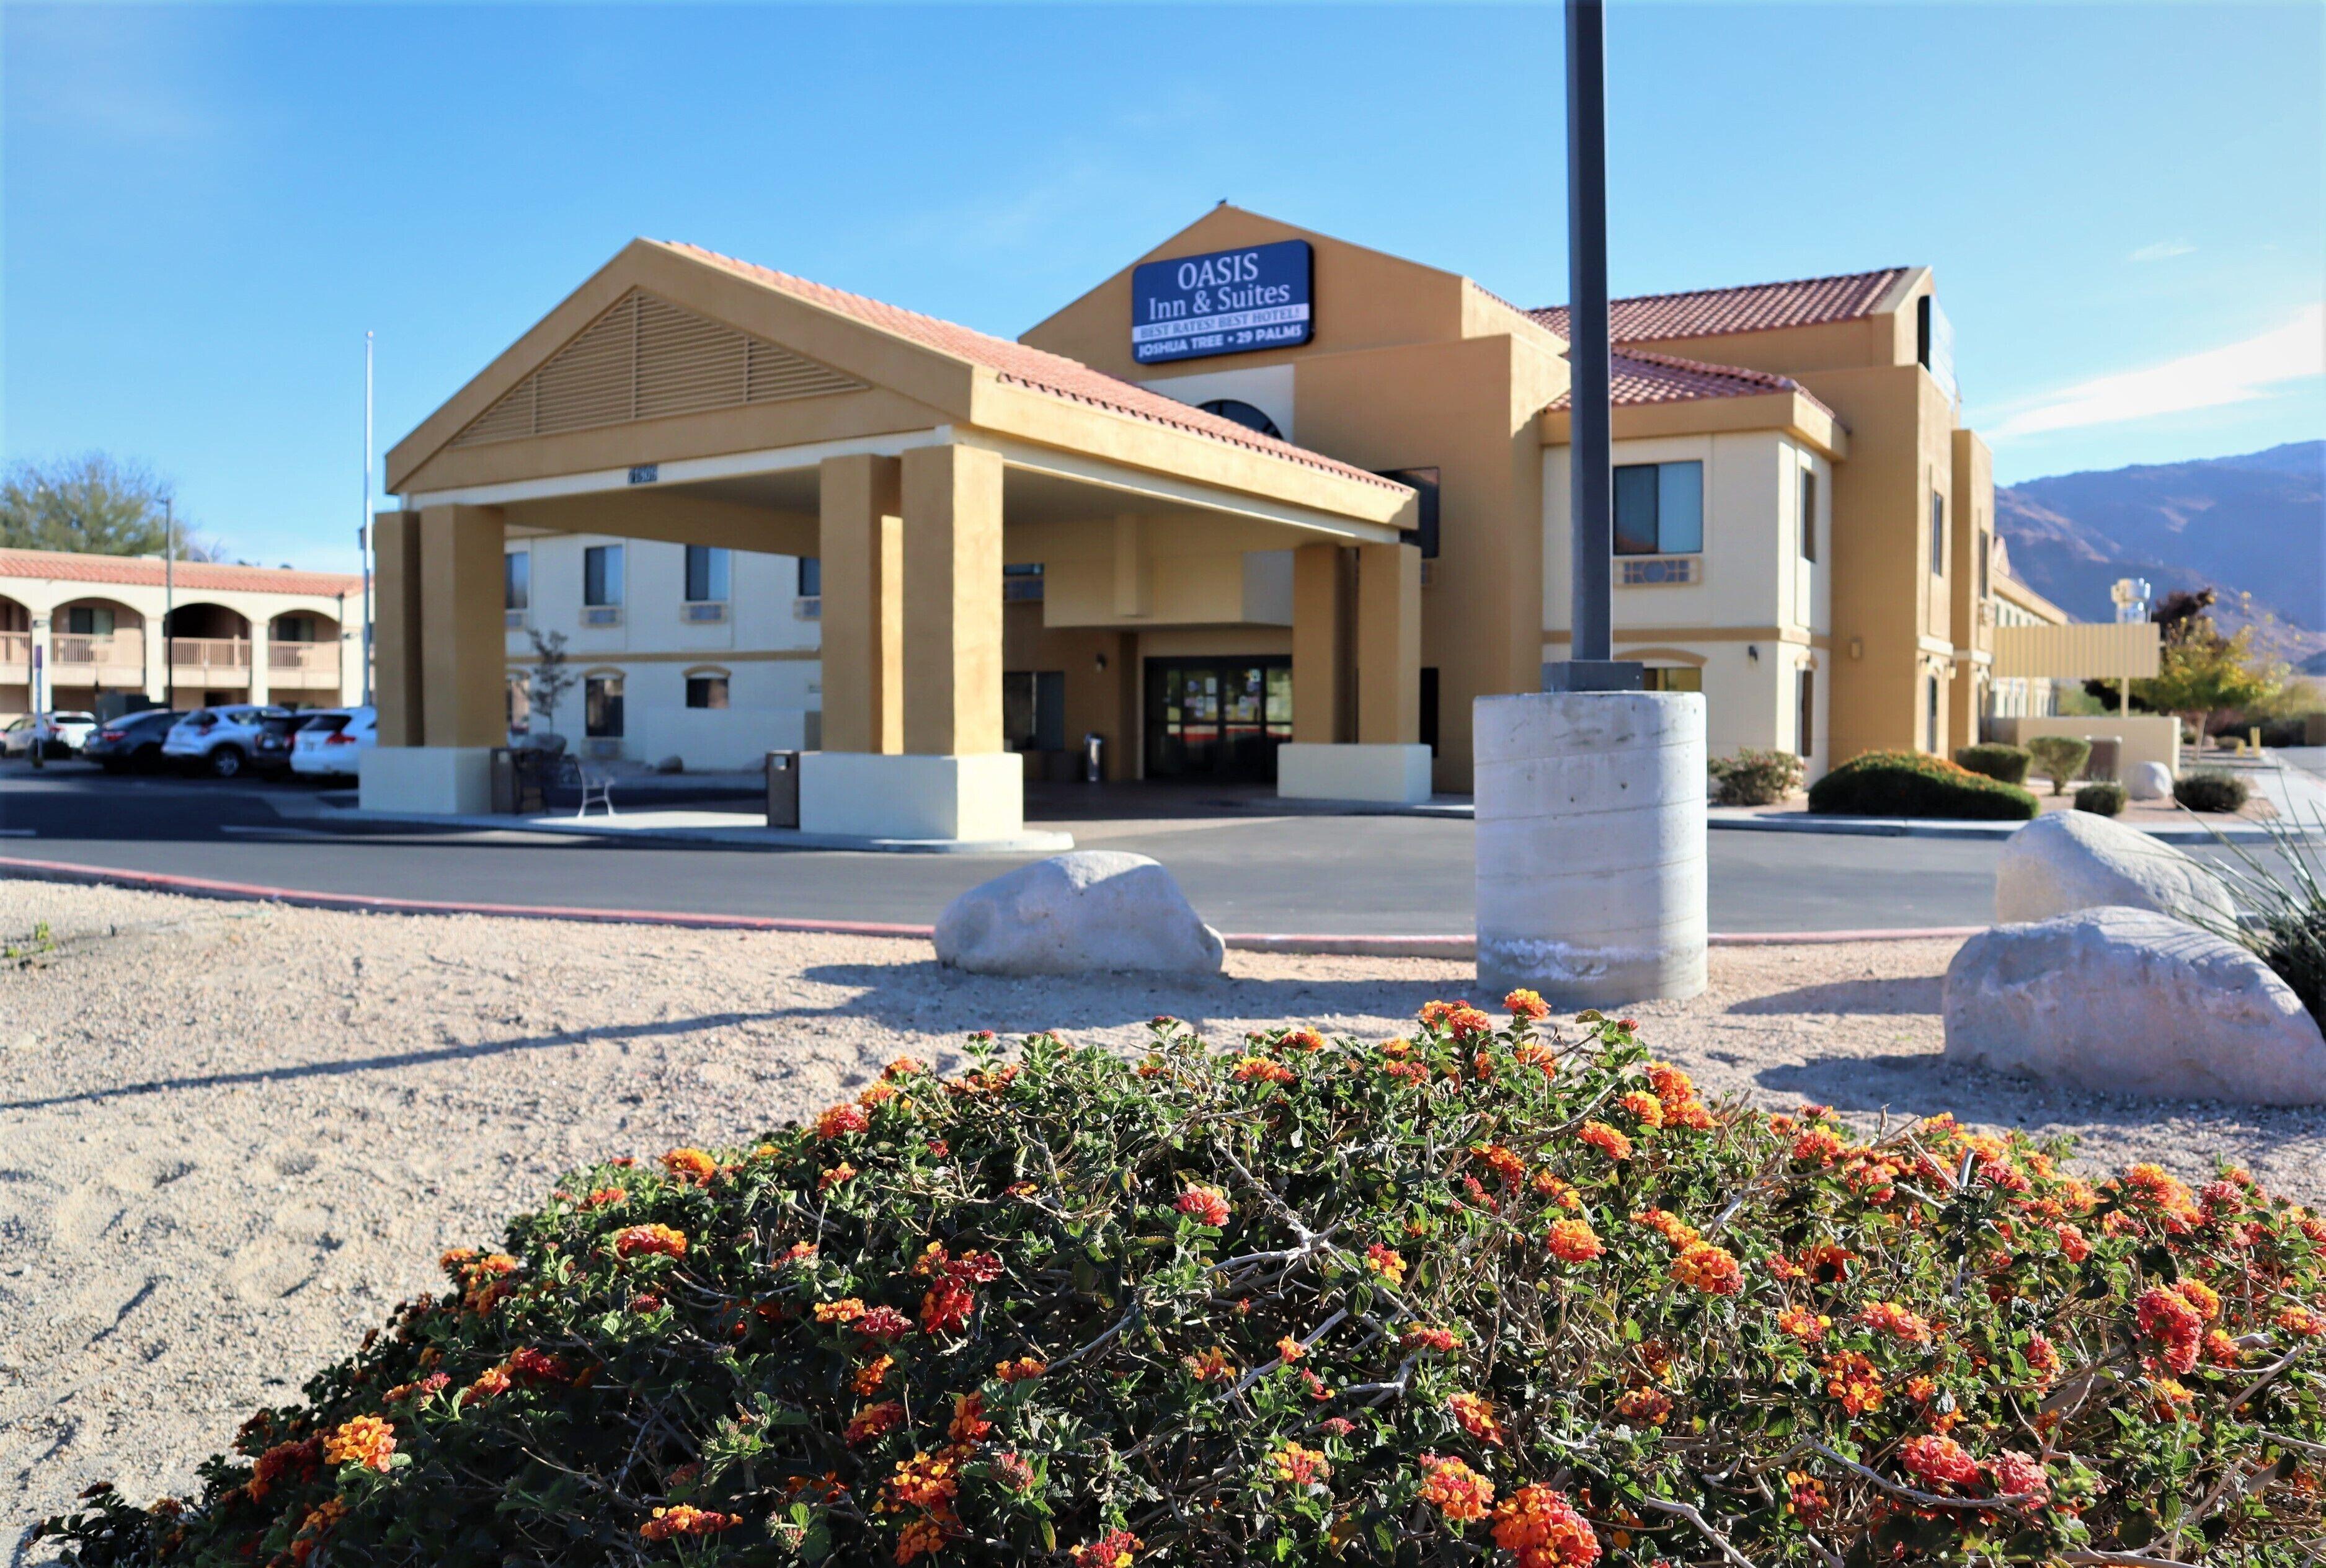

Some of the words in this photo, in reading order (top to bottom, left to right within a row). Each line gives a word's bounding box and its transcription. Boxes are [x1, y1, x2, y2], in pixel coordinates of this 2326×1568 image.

[1178, 252, 1259, 290] OASIS
[1149, 297, 1186, 321] Inn
[1192, 290, 1213, 314] &
[1217, 283, 1291, 311] Suites
[1140, 323, 1171, 339] BEST
[1172, 317, 1216, 335] RATES!
[1218, 312, 1248, 329] BEST
[1251, 306, 1300, 324] HOTEL!
[1138, 337, 1189, 358] JOSHUA
[1191, 332, 1225, 350] TREE
[1236, 330, 1253, 345] 29
[1254, 324, 1303, 342] PALMS
